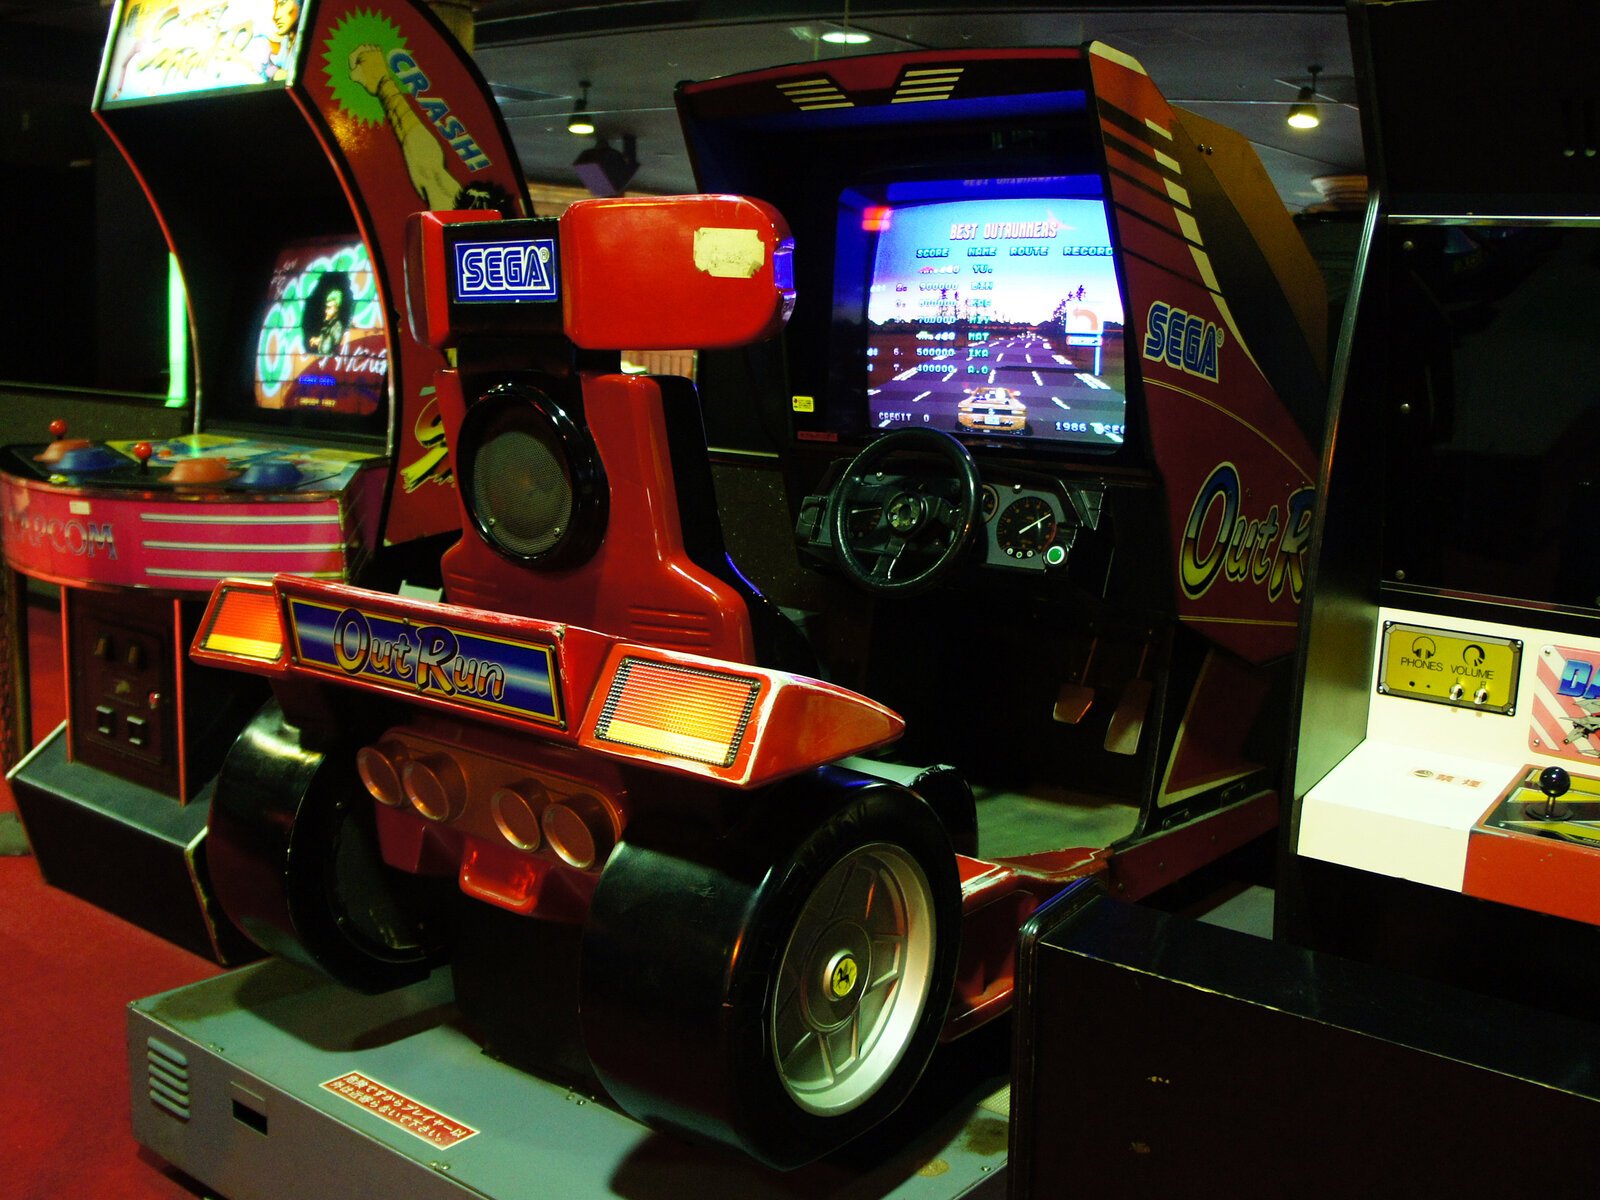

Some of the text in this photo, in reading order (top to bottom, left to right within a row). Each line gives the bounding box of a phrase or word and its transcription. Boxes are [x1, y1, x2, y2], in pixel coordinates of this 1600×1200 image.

[387, 48, 493, 173] CRASH!
[950, 220, 1057, 241] BEST OUTRUNNERS
[915, 246, 1114, 258] SCORE NAME ROUTE RECORD
[462, 246, 550, 291] SEGA
[967, 331, 990, 341] MAT
[1143, 300, 1220, 384] SEGA
[916, 347, 955, 357] 500000
[878, 411, 912, 421] CREDIT
[1055, 421, 1087, 433] 1986
[333, 607, 506, 700] OutRun
[1400, 656, 1495, 681] PHONES VOLUME
